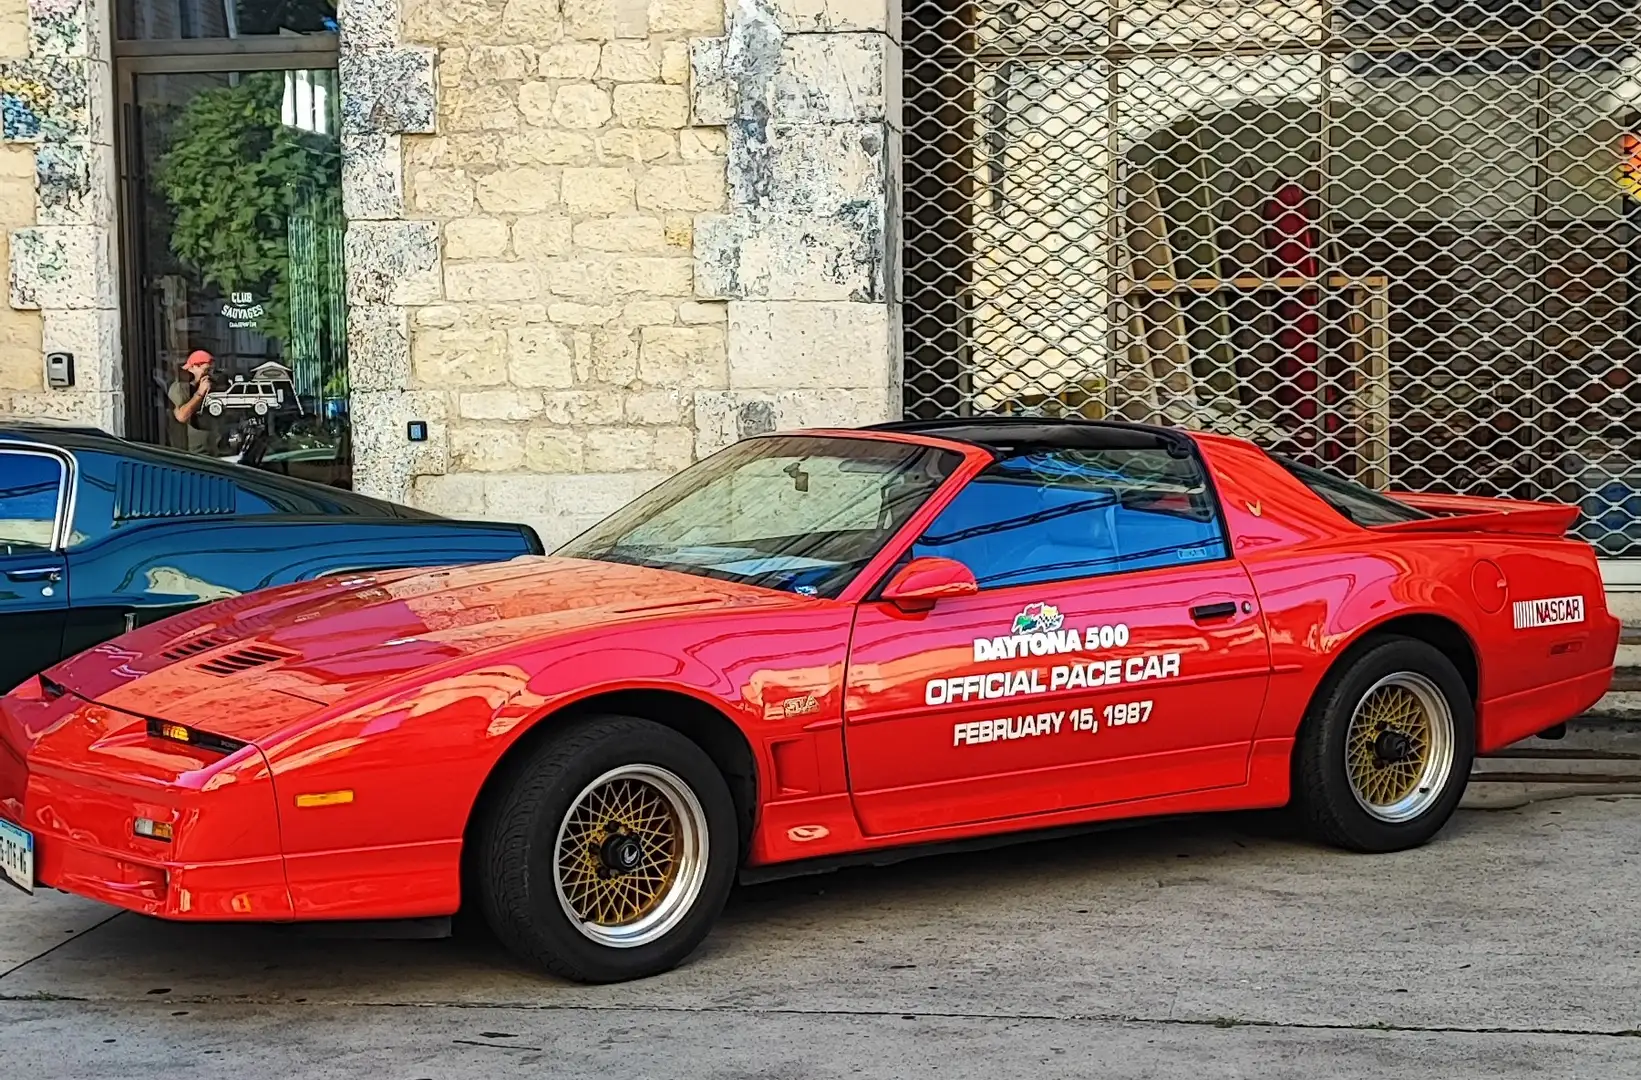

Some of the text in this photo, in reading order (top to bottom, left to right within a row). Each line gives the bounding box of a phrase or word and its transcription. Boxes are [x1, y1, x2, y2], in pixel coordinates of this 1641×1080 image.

[221, 304, 264, 319] SAUVAGES
[231, 292, 252, 303] CLUB
[1535, 598, 1581, 624] NASCAR
[973, 624, 1129, 662] DAYTONA 500
[925, 653, 1181, 705] OFFICIAL PACE CAR
[953, 700, 1153, 746] FEBRUARY 15, 1987
